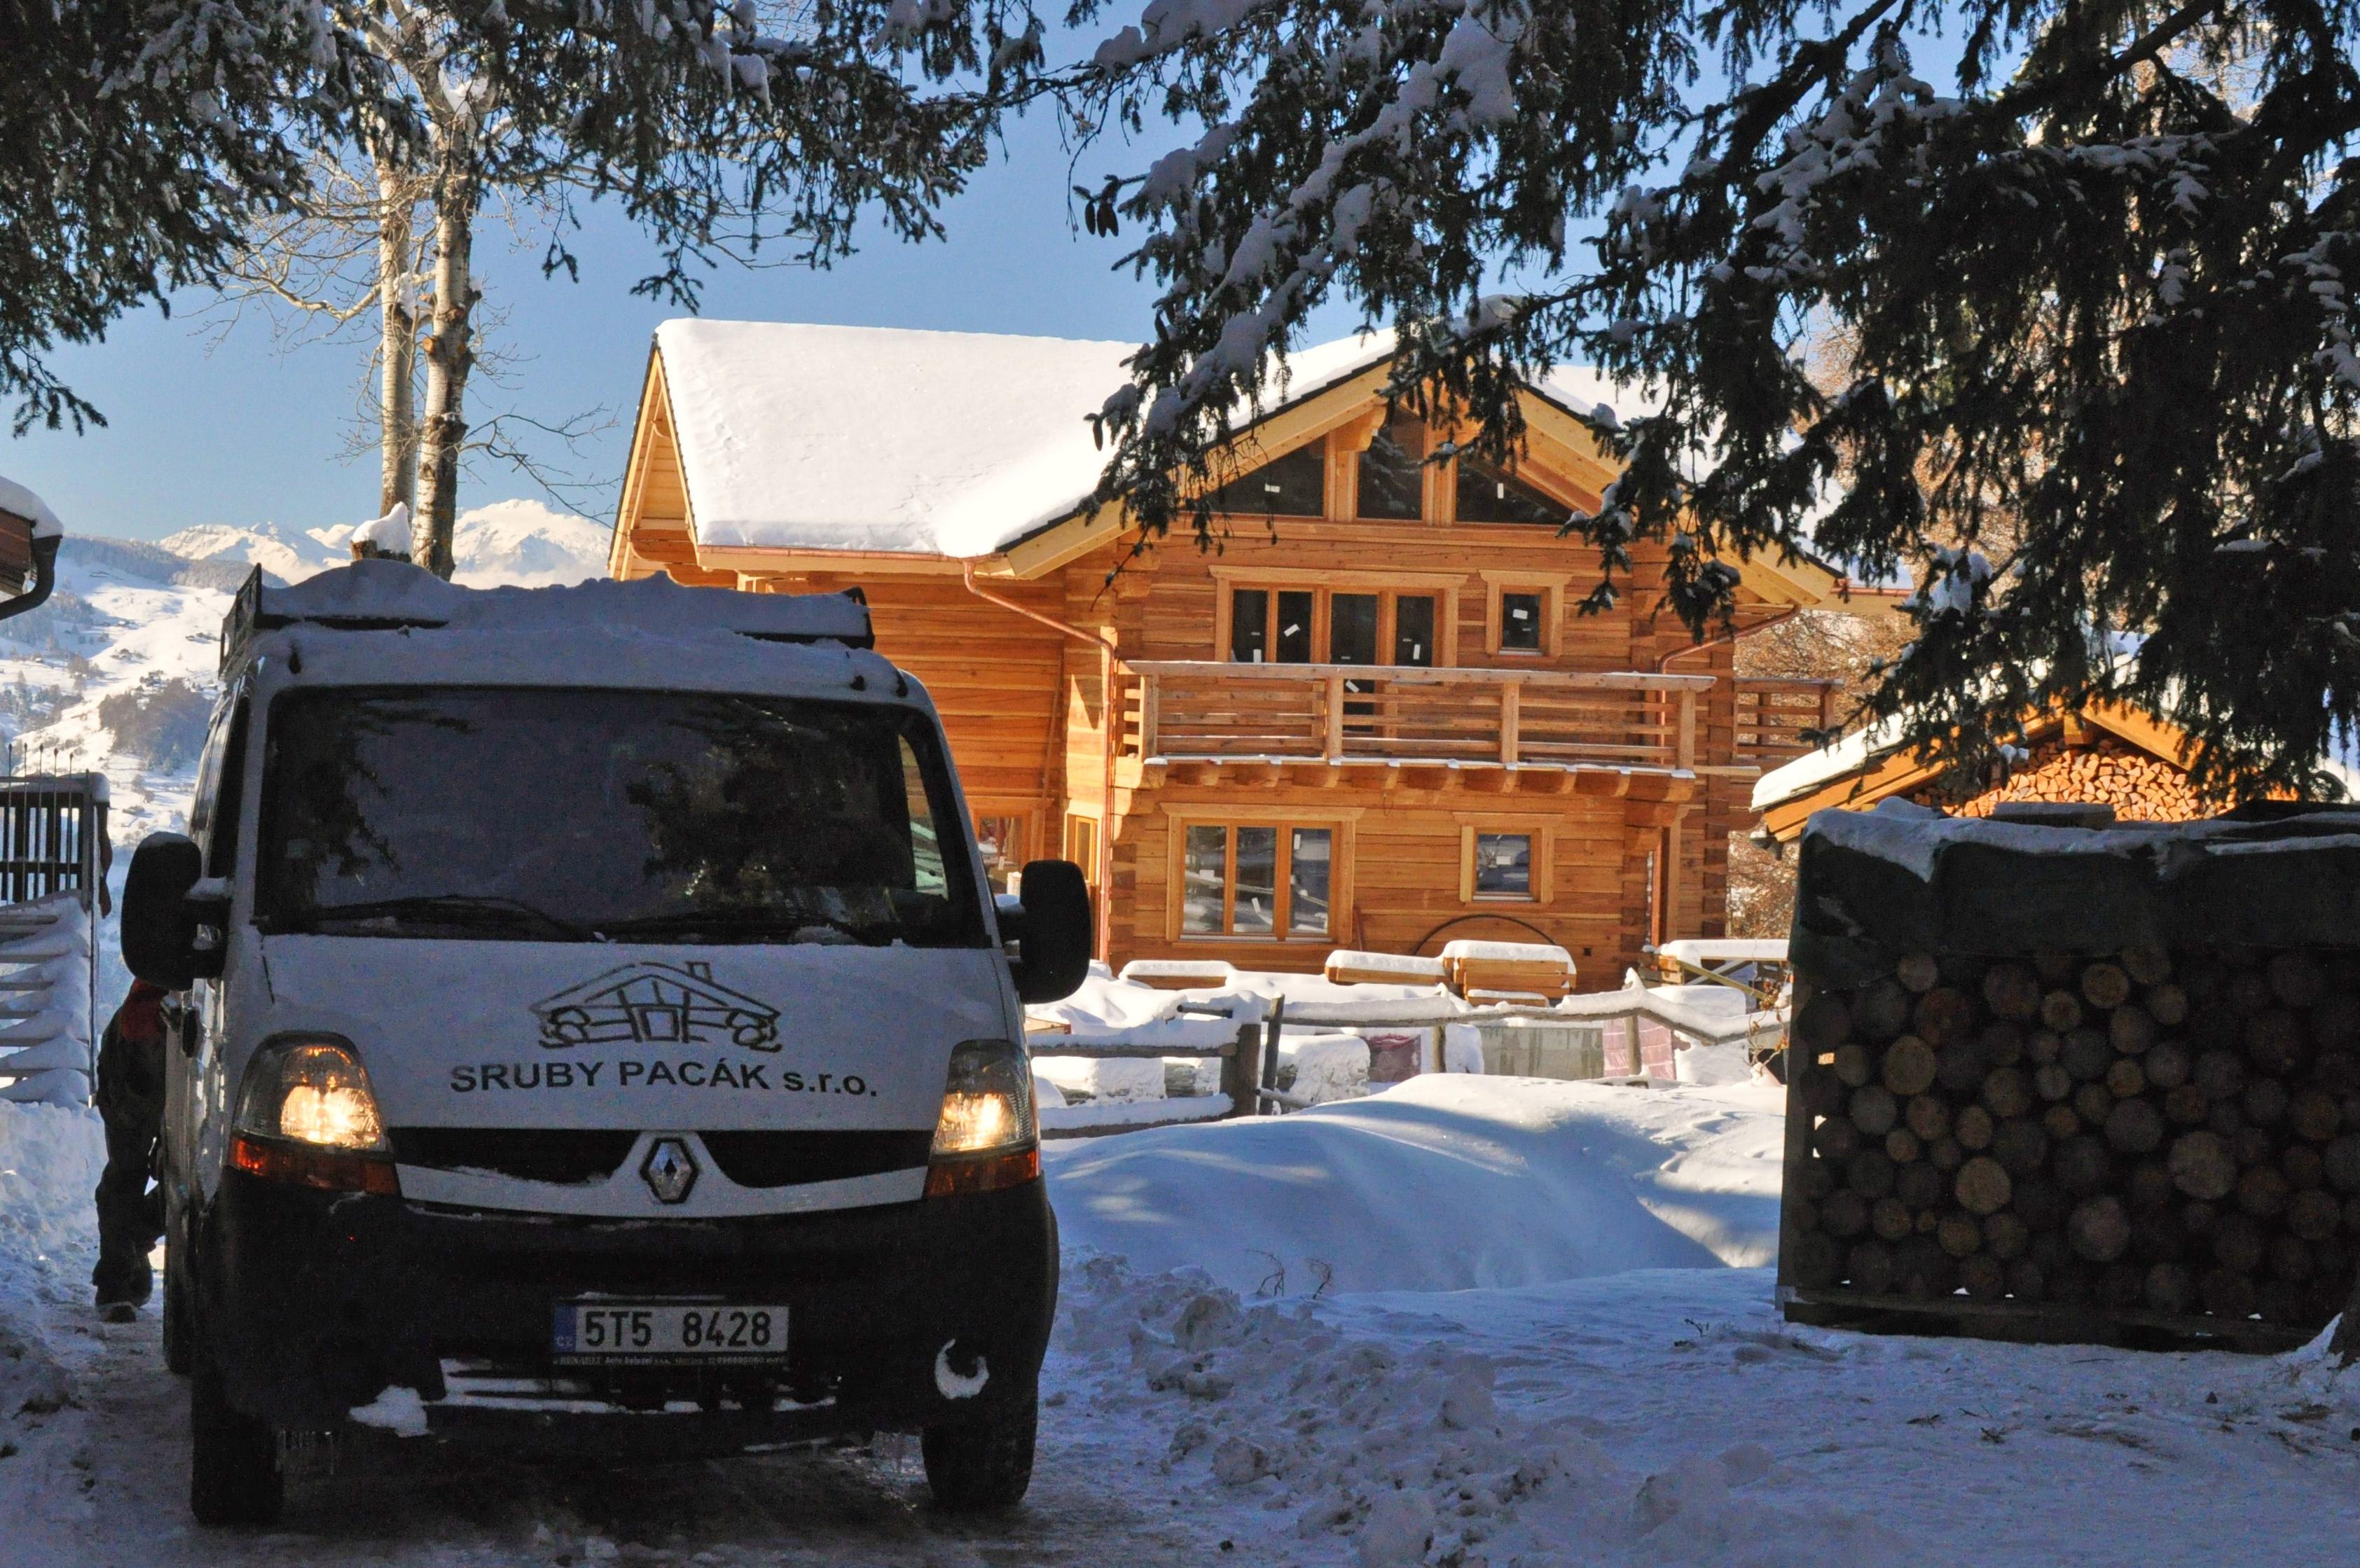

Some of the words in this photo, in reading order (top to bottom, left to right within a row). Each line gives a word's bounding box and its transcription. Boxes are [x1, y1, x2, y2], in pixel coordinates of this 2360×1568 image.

[450, 1062, 604, 1093] SRUBY
[619, 1056, 771, 1090] PACÁK
[783, 1071, 878, 1098] s.r.o.
[585, 1310, 652, 1347] 5T5
[682, 1311, 771, 1347] 8428
